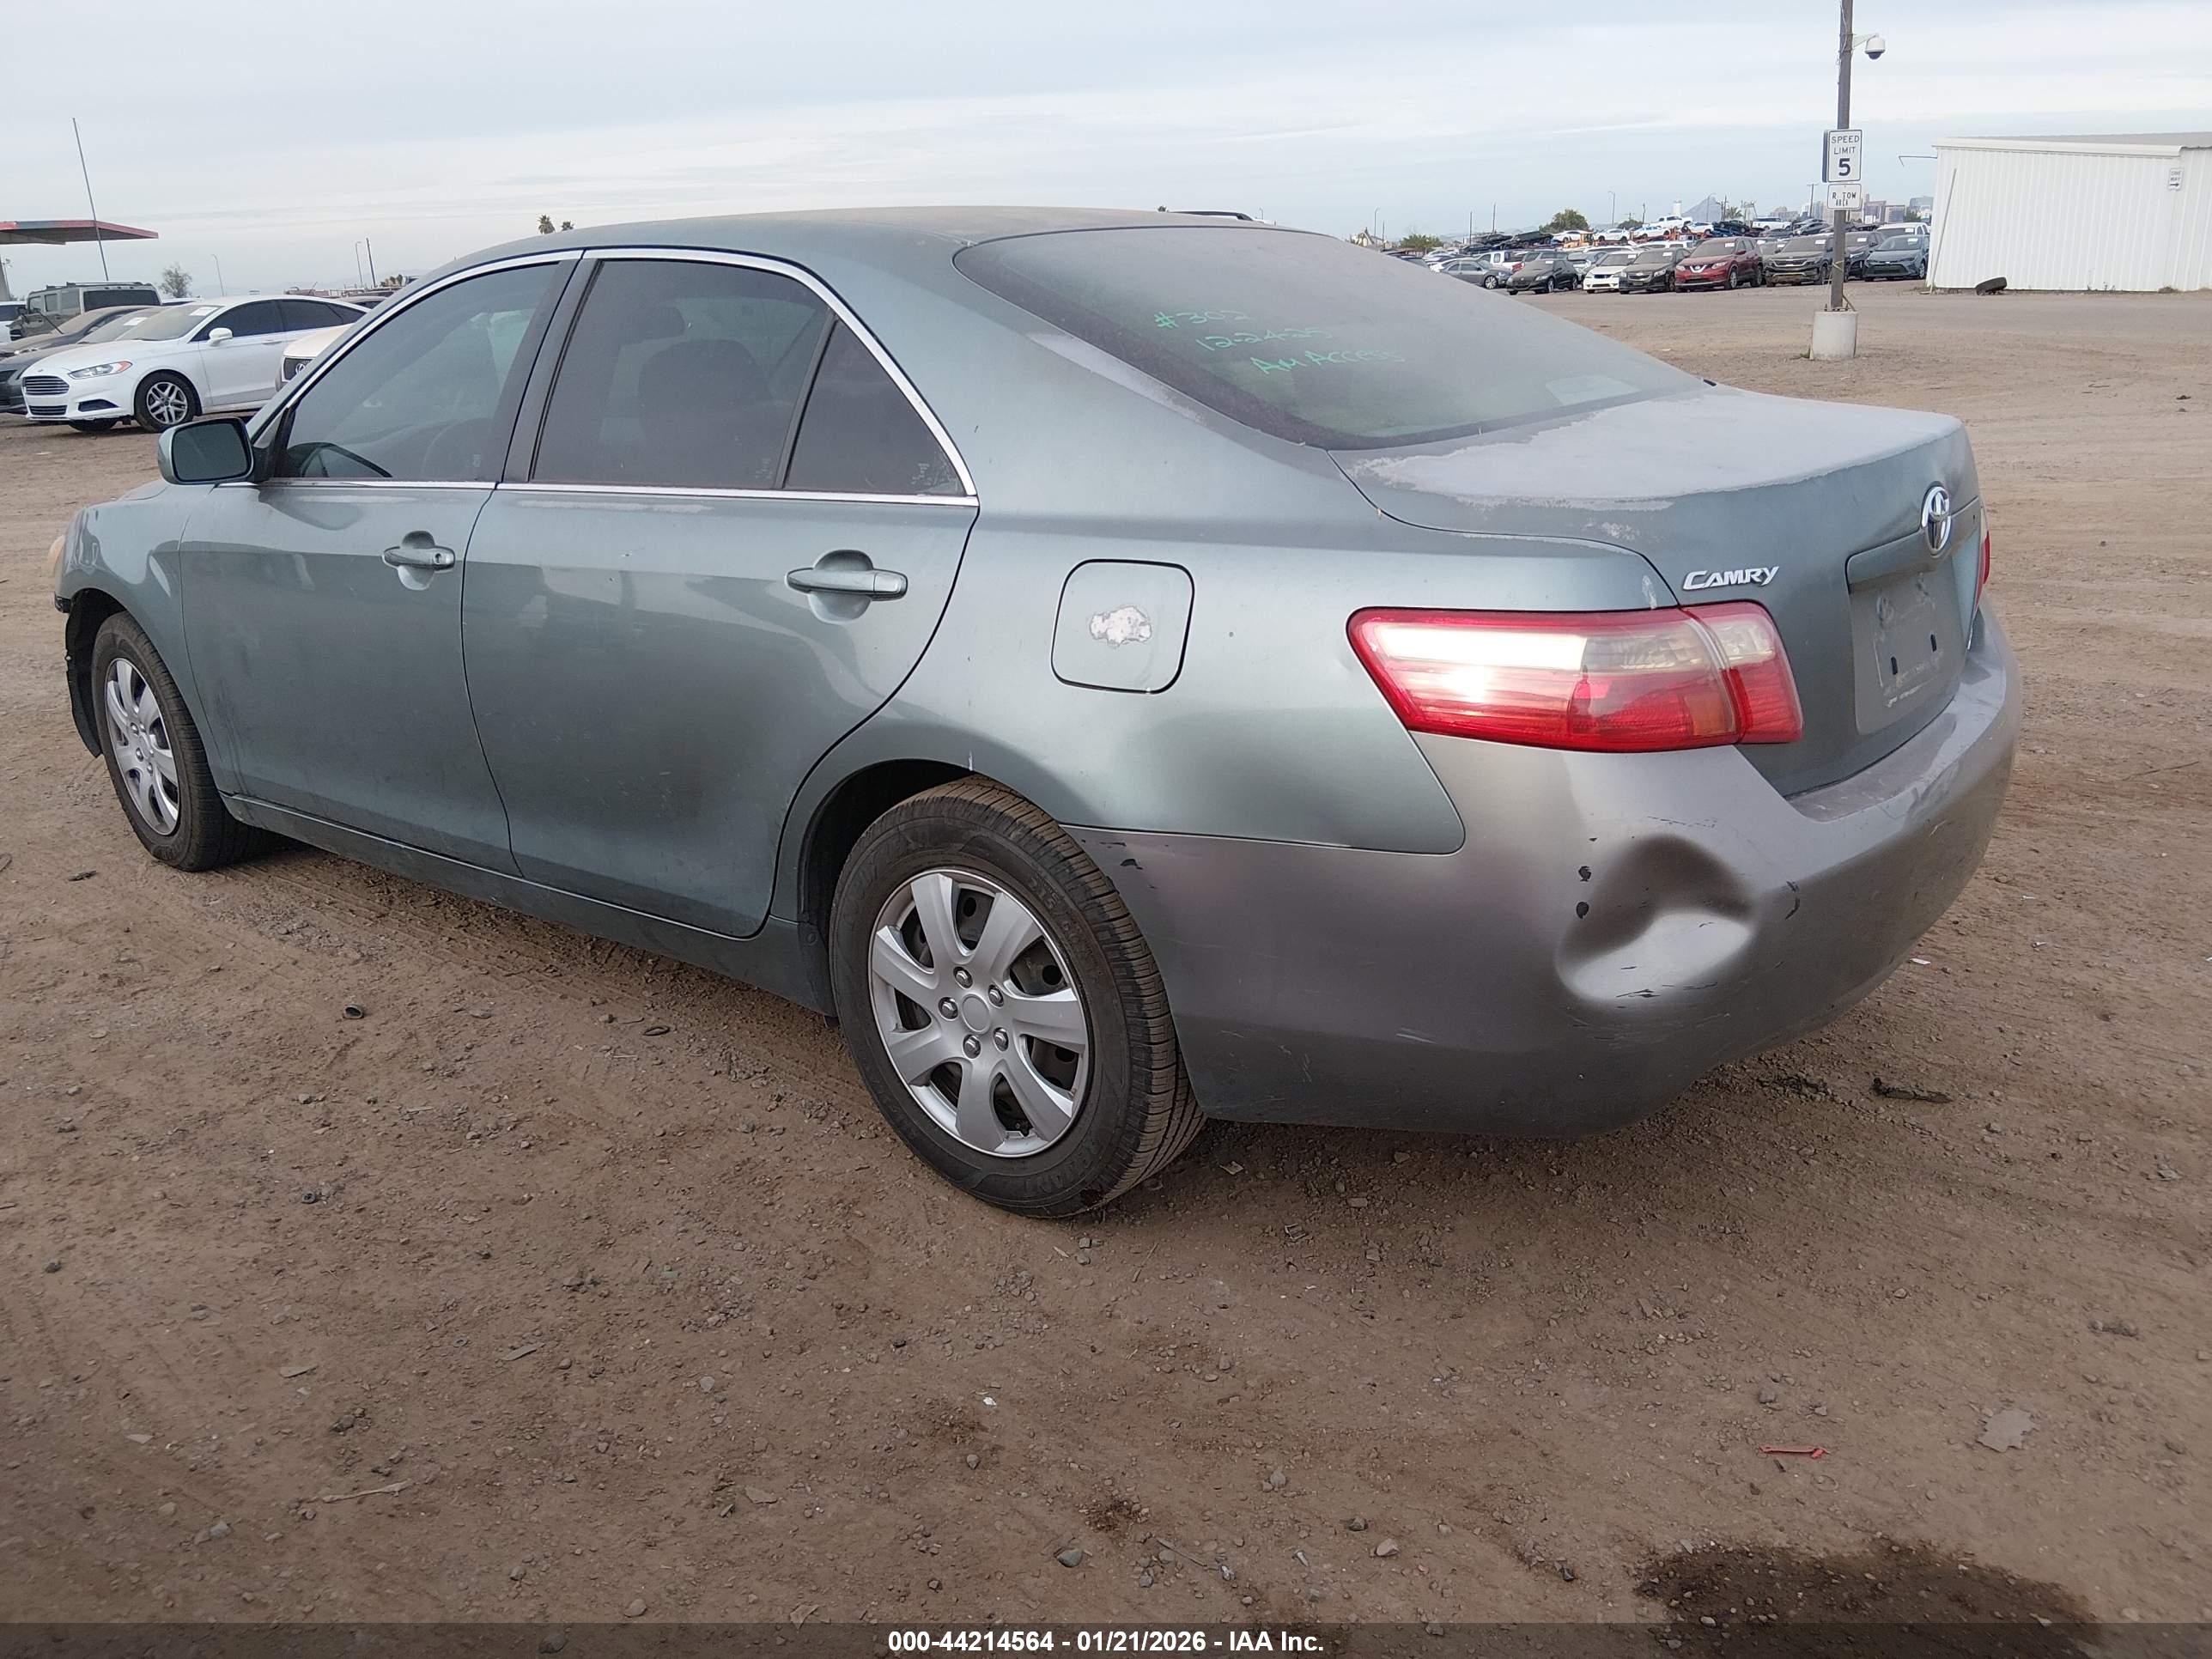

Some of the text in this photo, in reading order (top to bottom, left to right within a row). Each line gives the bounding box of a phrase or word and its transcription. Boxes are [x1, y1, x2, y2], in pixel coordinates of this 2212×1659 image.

[1831, 136, 1860, 144] SPEED
[1838, 158, 1851, 177] 5
[1683, 566, 1780, 591] CAMRY
